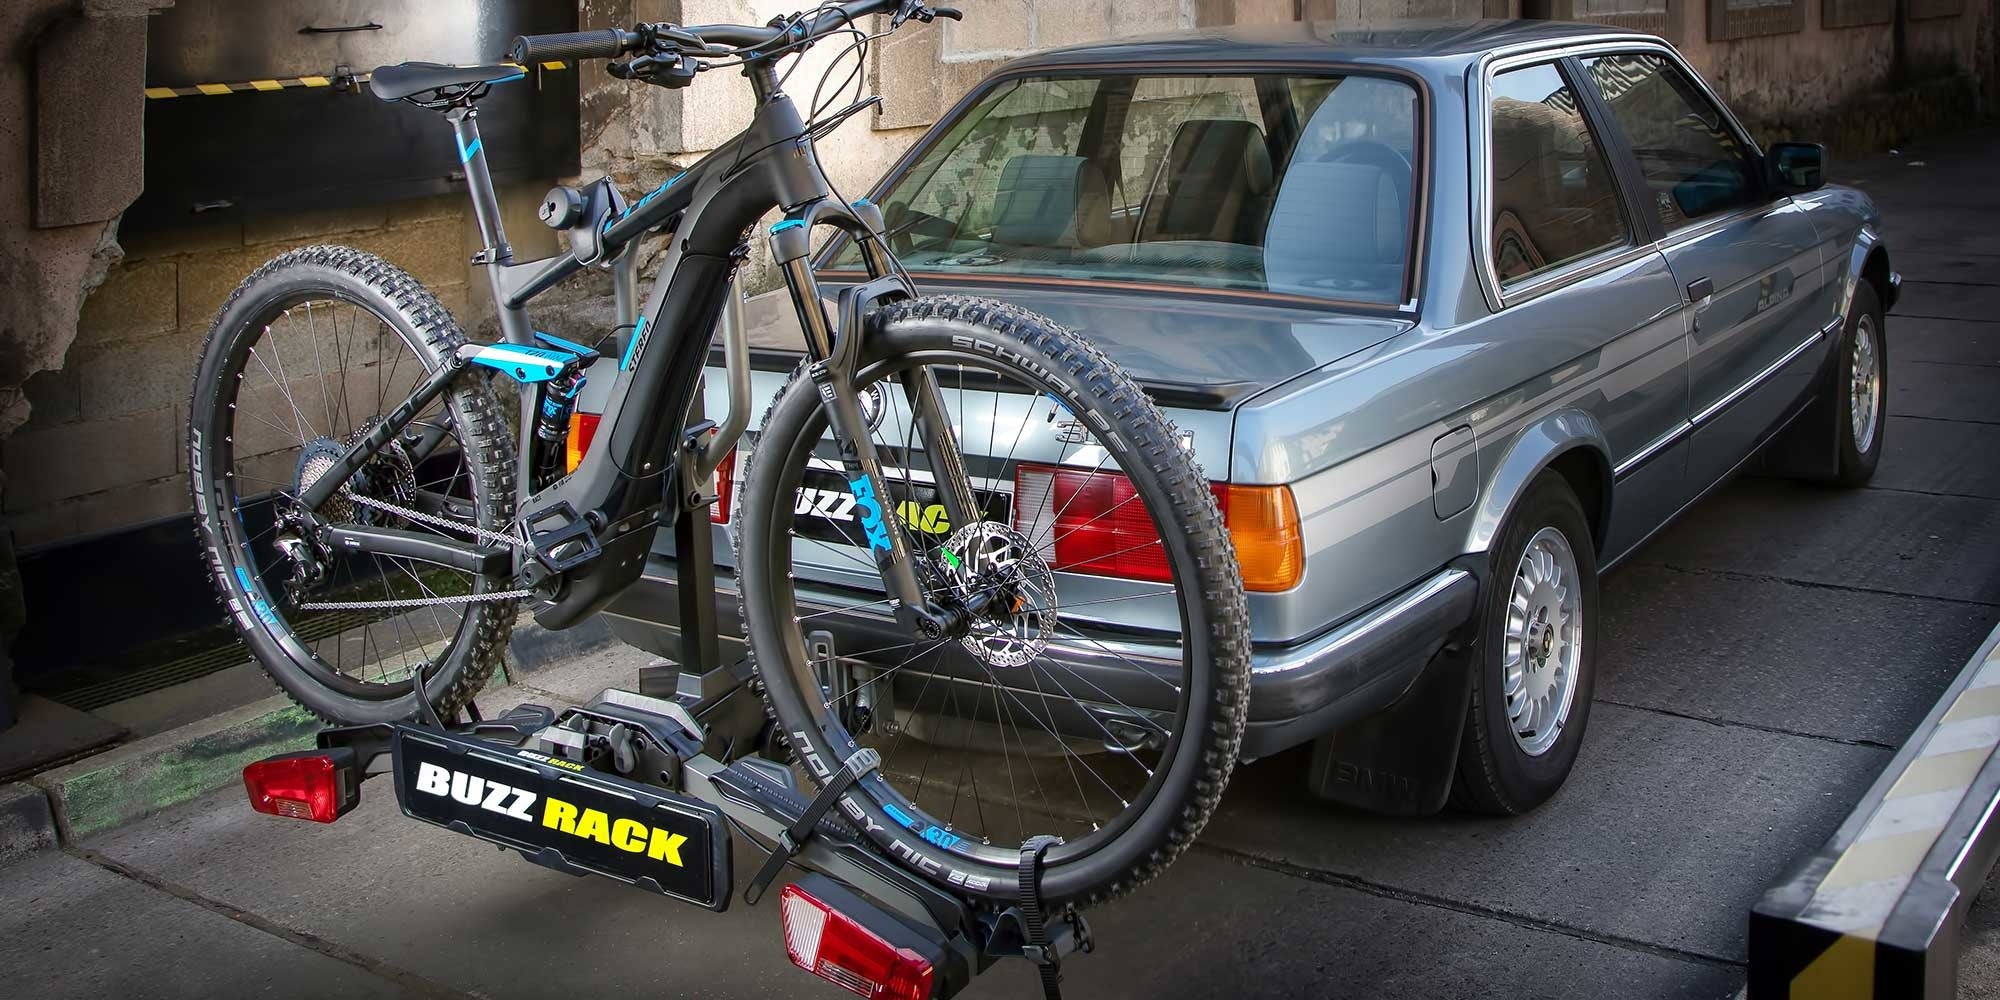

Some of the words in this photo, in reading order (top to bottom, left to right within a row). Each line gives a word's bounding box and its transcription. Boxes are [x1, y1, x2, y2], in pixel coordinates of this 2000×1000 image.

[952, 335, 1128, 452] SCHWALBE
[192, 428, 213, 534] NOBBY
[208, 547, 233, 591] NIC
[794, 487, 856, 521] UZZ
[849, 474, 892, 559] FOX
[547, 758, 585, 771] RACK
[415, 761, 538, 822] BUZZ
[542, 796, 689, 868] RACK
[889, 839, 942, 876] NIC
